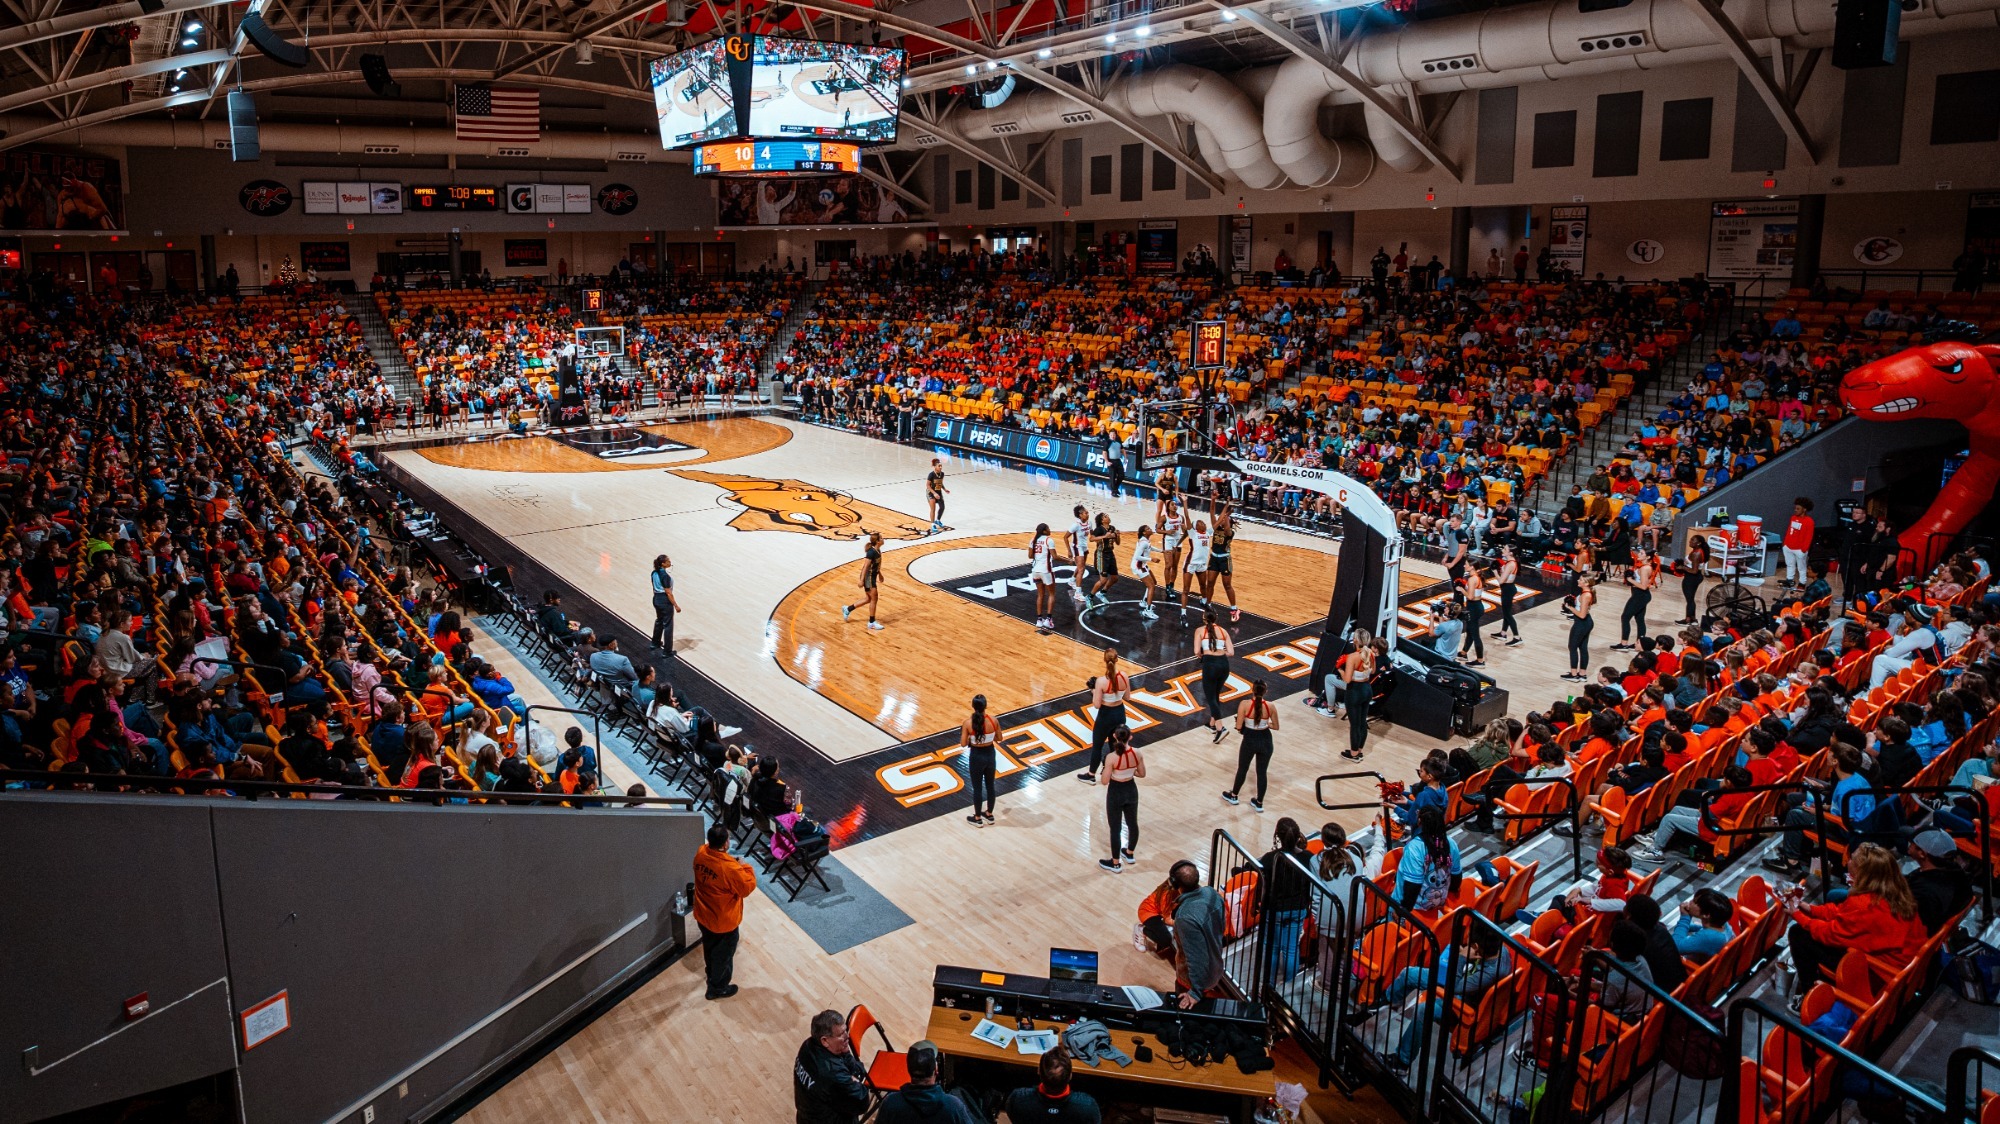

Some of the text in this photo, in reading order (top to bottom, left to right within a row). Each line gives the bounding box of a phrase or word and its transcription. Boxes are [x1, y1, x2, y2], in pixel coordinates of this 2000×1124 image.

[735, 146, 751, 161] 10
[761, 145, 771, 160] 4
[820, 162, 834, 170] 7:08
[448, 187, 470, 199] 7:08
[421, 195, 432, 207] 10
[487, 195, 495, 207] 4
[507, 249, 545, 260] CAMELS
[589, 298, 599, 309] 19
[1201, 326, 1221, 339] 7:08
[1204, 340, 1218, 361] 19
[969, 430, 1003, 447] PEPSI
[598, 443, 689, 457] CAA
[1246, 462, 1324, 480] GOCAMELS.COM
[1338, 489, 1348, 503] C
[957, 565, 1090, 600] CAA
[695, 863, 719, 881] STAFF
